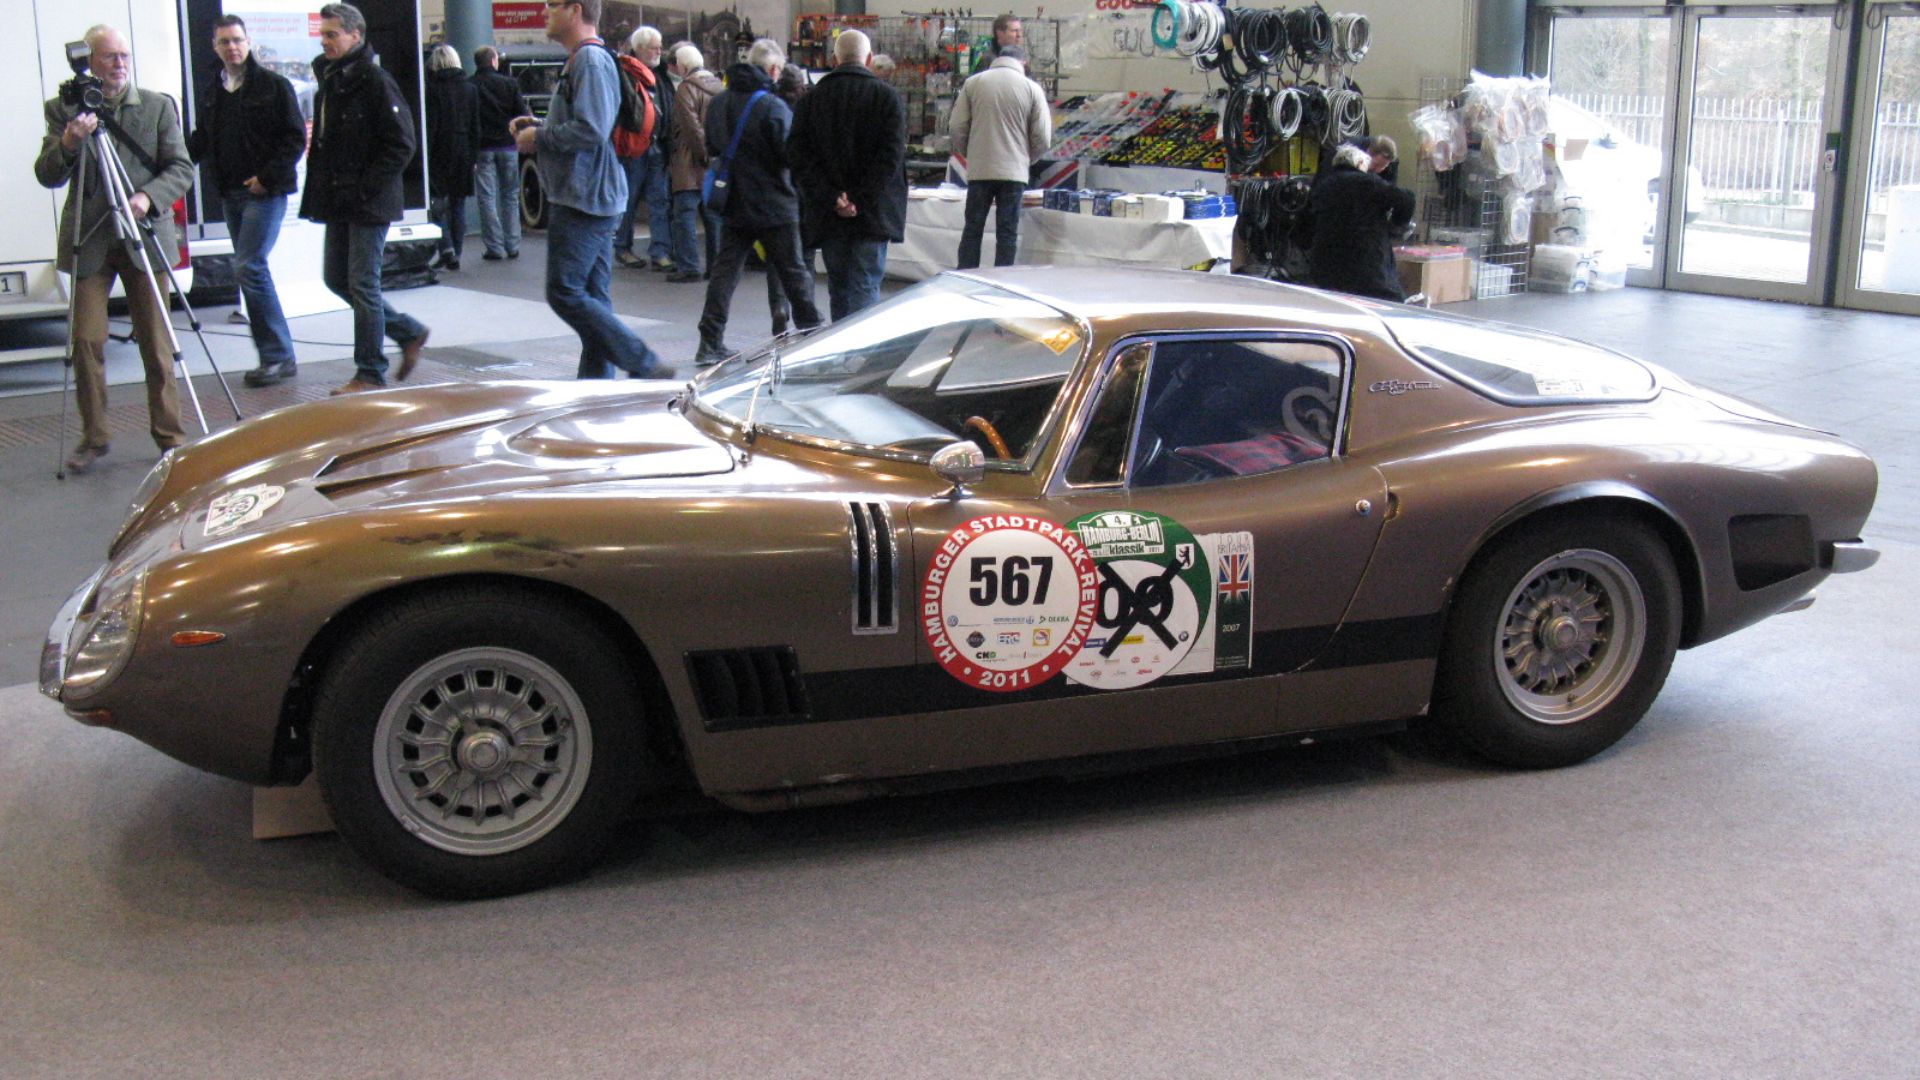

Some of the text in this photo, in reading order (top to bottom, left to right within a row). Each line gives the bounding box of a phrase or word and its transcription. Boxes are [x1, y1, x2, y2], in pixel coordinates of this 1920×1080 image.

[1109, 544, 1145, 555] klassik
[924, 515, 1097, 664] HAMBURGER STADTPARK-REVIVAL
[969, 555, 1054, 607] 567
[1222, 623, 1241, 632] 2007
[978, 669, 1031, 688] 2011
